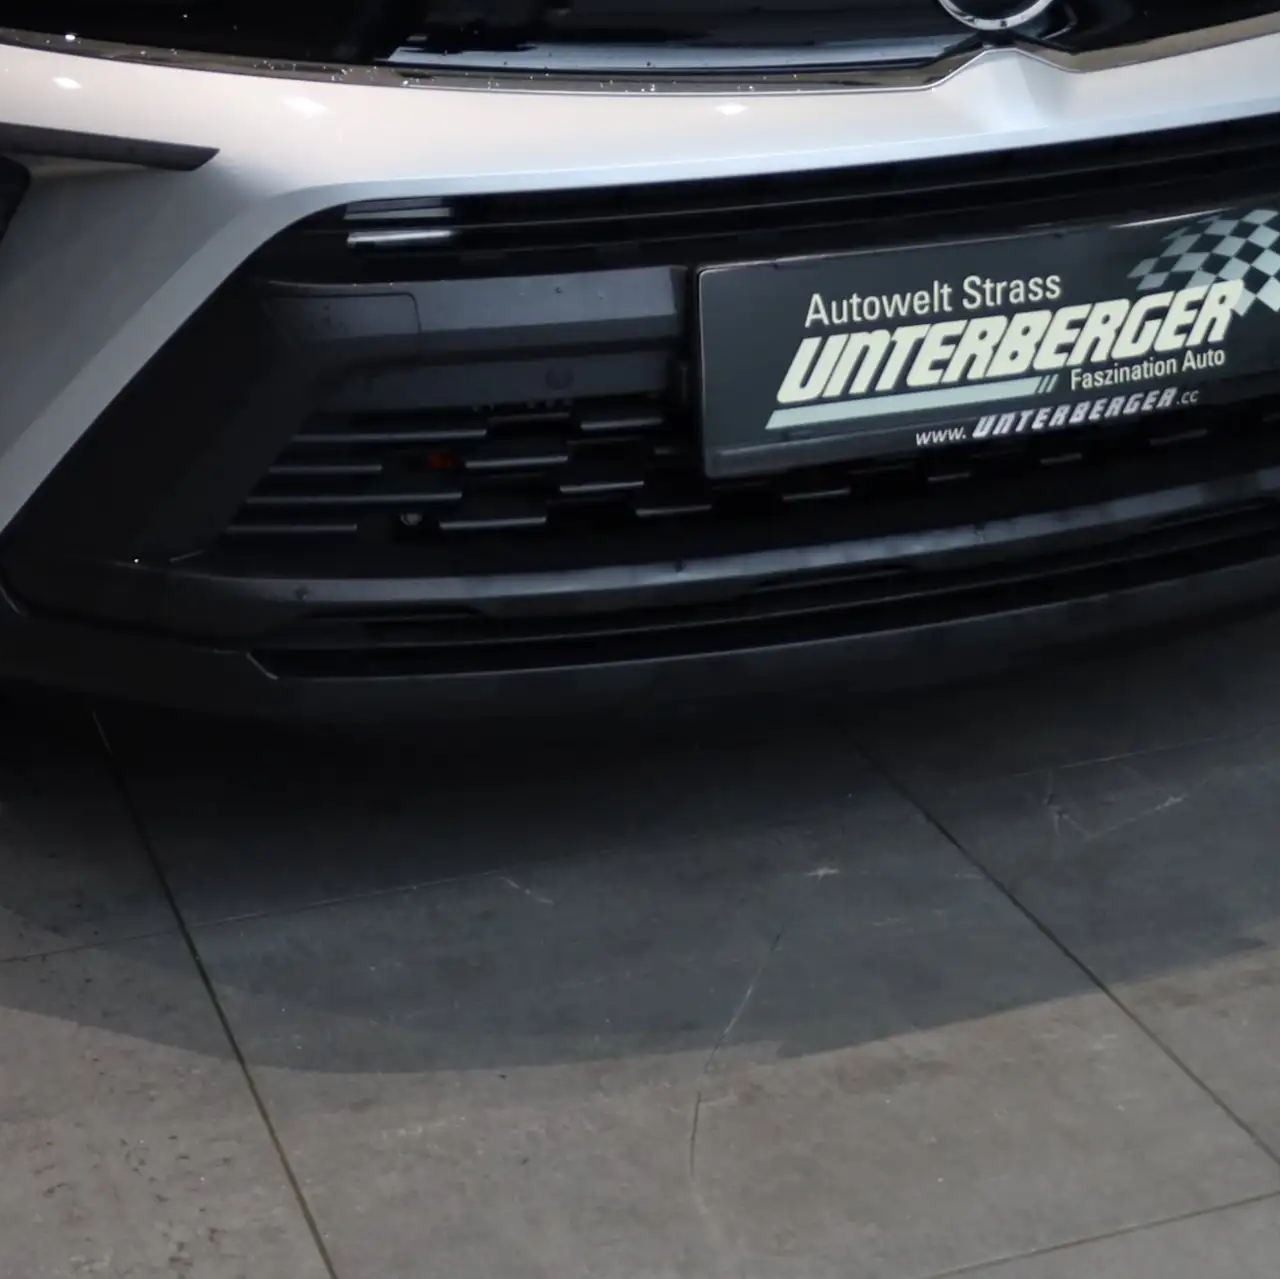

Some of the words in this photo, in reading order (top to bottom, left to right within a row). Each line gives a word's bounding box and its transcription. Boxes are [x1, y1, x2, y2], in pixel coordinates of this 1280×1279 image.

[805, 280, 953, 328] Autowelt
[962, 275, 1062, 310] Strass
[776, 278, 1244, 403] UNTERBERGER
[1070, 361, 1178, 392] Faszination
[1181, 349, 1226, 371] Auto
